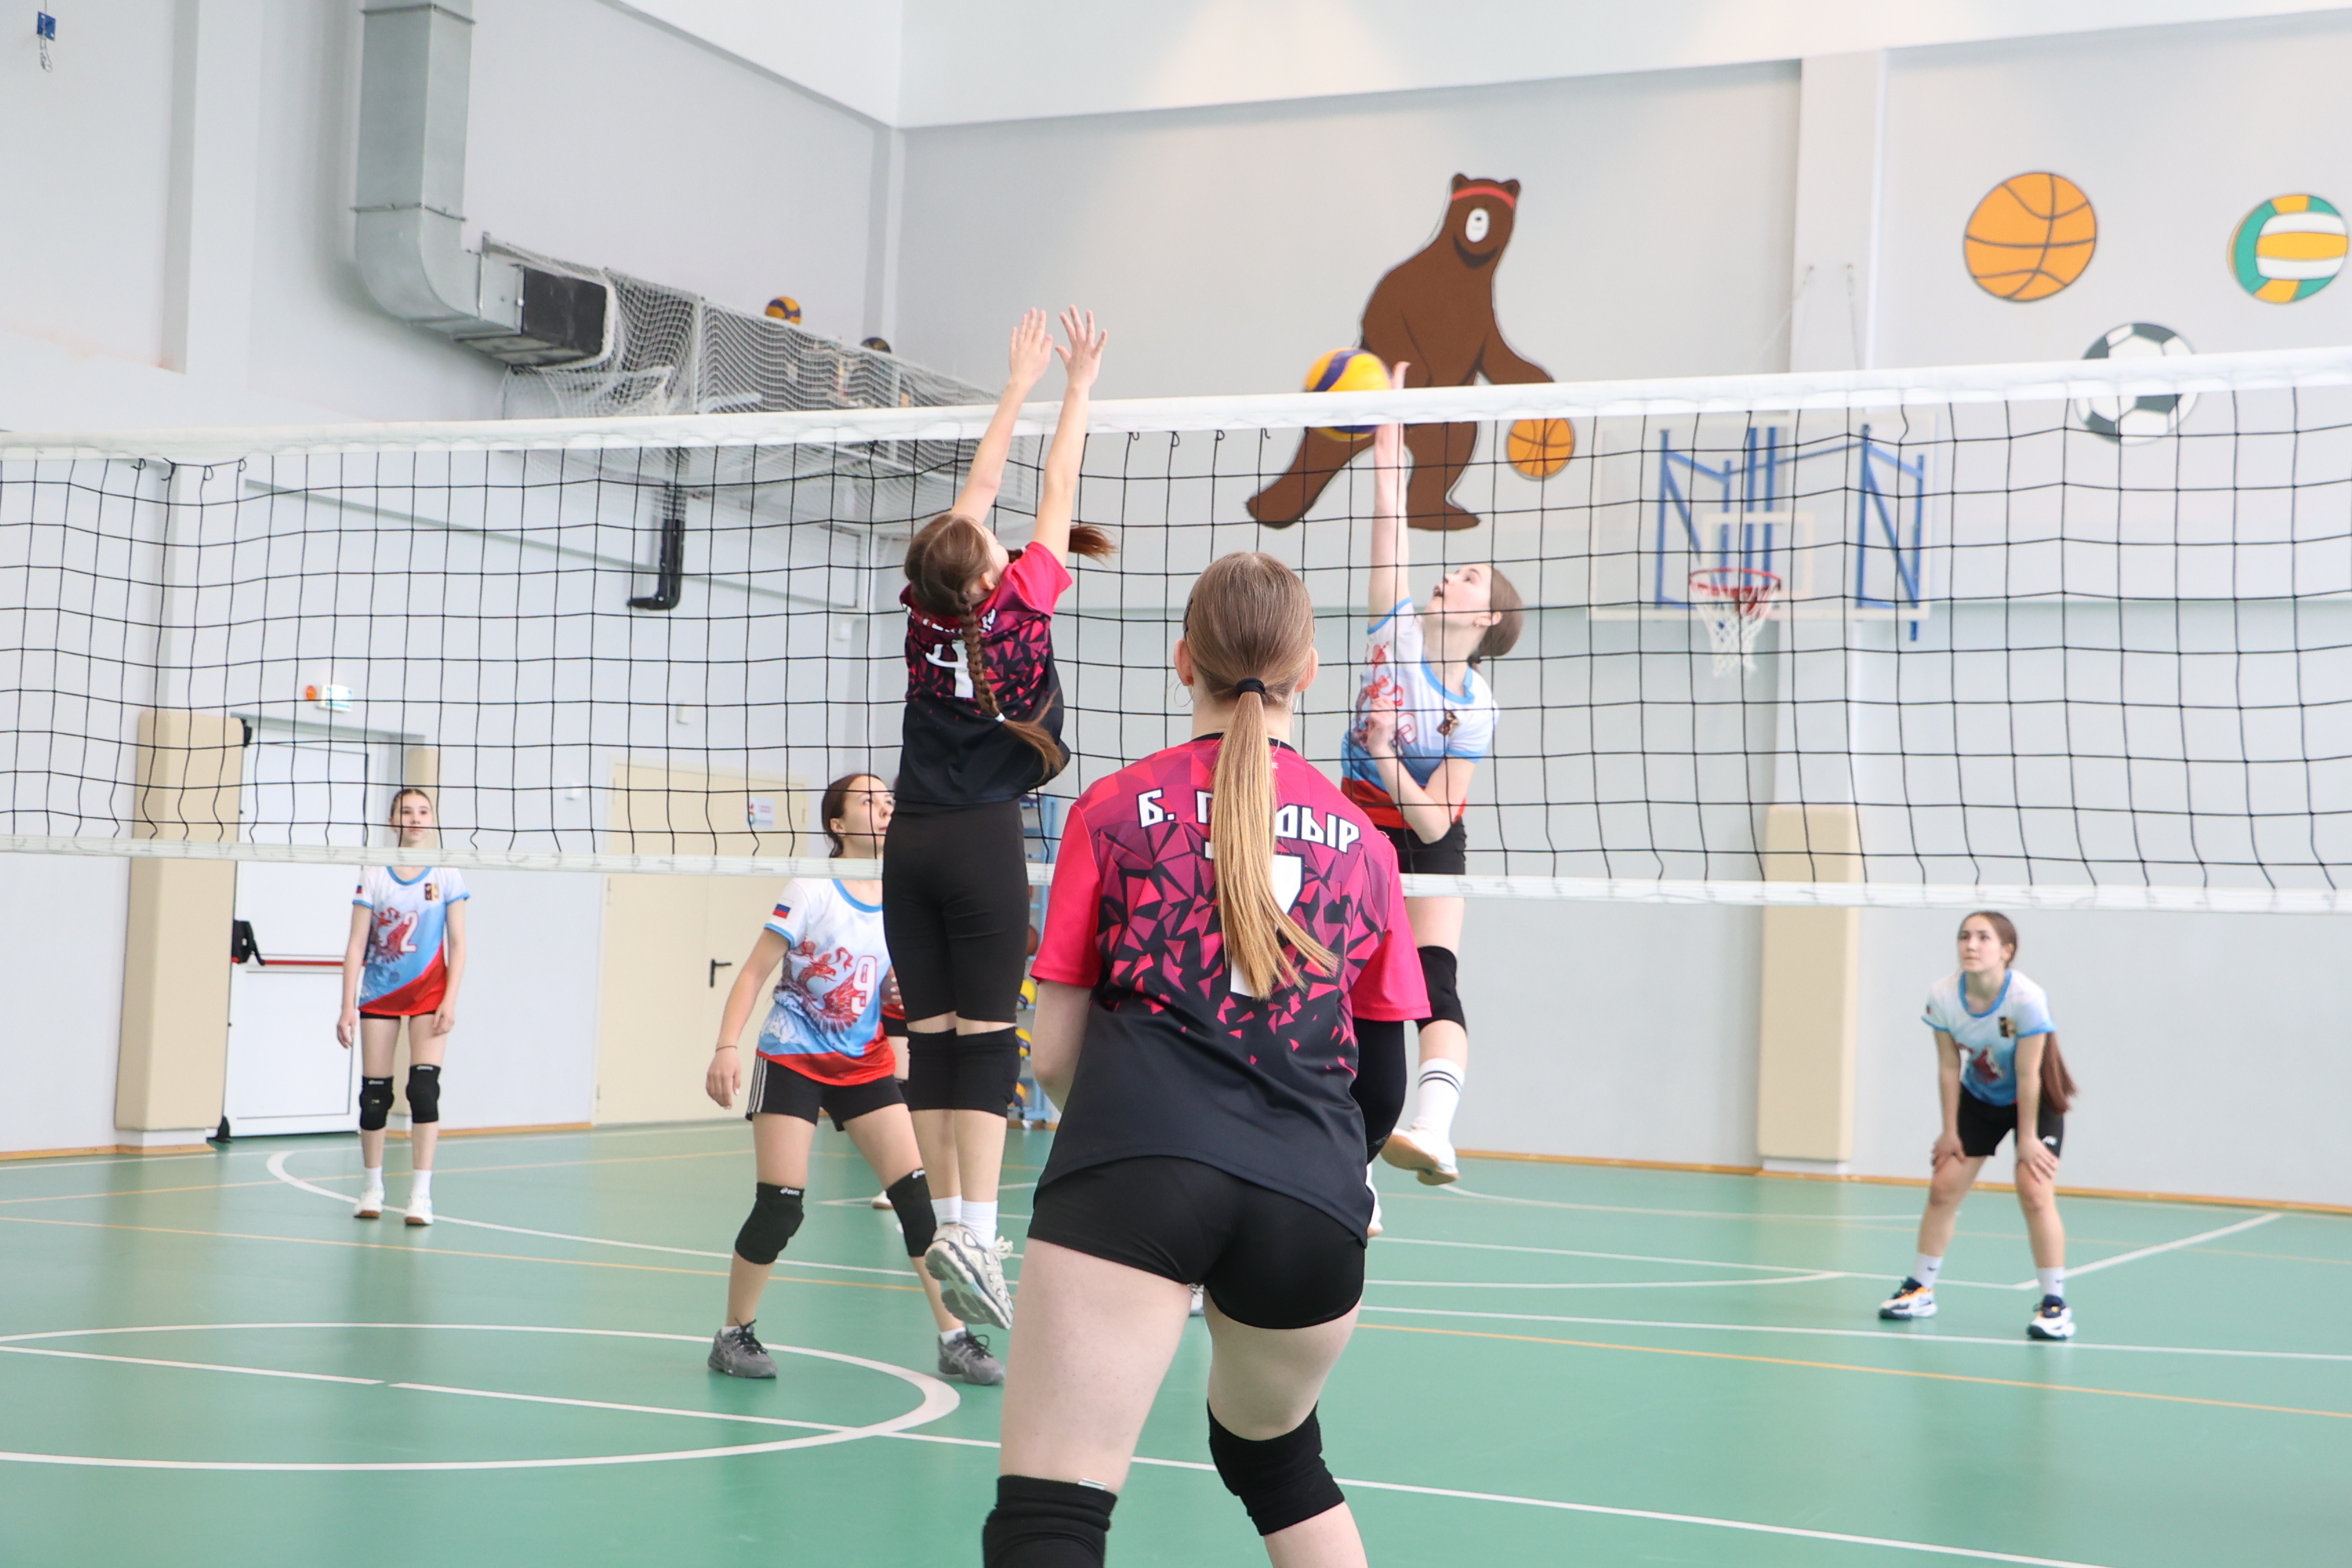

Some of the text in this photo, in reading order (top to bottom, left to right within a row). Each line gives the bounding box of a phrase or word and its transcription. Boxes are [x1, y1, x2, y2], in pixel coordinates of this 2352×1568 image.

[1137, 788, 1360, 854] Б. ГДЫР
[400, 910, 419, 953] 2
[851, 955, 876, 1017] 9
